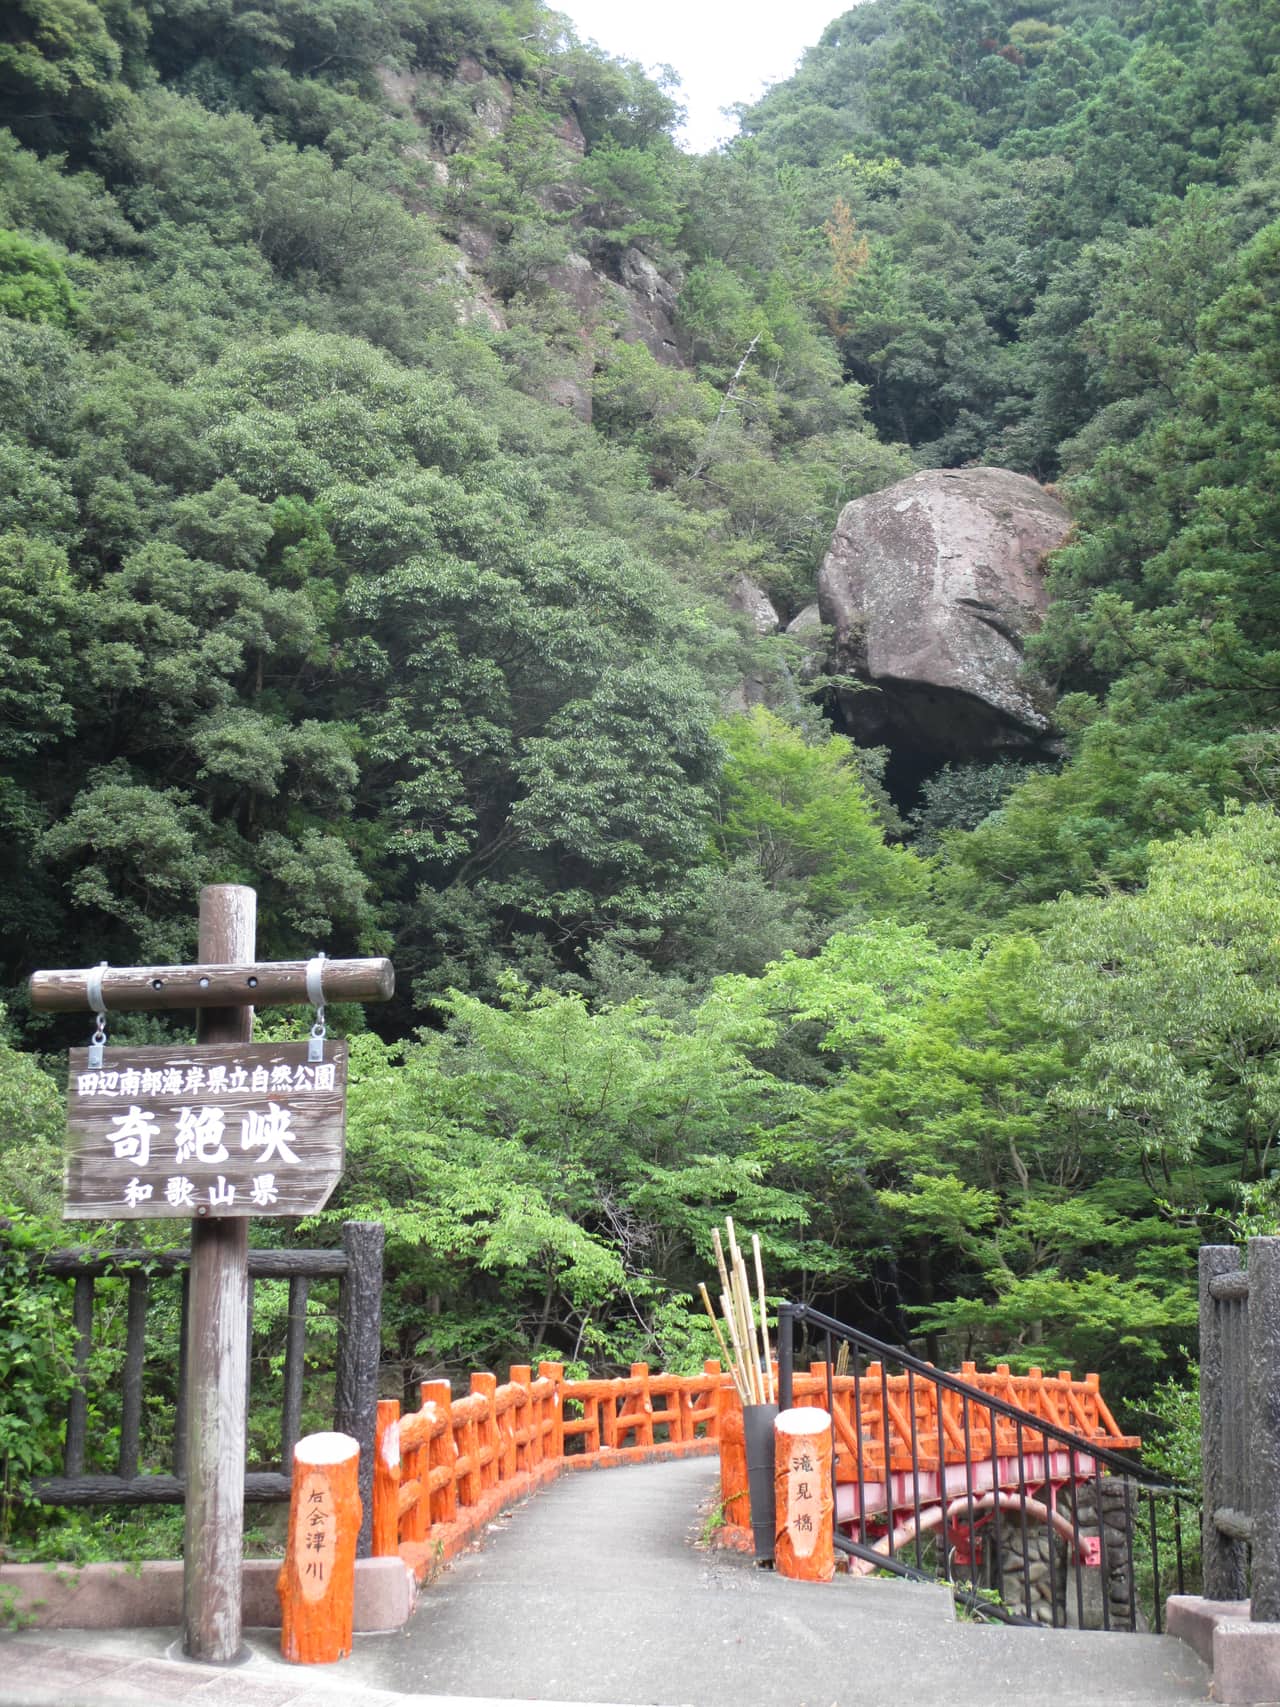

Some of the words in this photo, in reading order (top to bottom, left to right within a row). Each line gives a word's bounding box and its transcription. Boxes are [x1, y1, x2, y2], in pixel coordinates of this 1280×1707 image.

[77, 1064, 336, 1097] 田辺南部海岸県立自然公園
[106, 1102, 302, 1167] 奇絶峡
[124, 1173, 279, 1207] 和歌山県
[793, 1455, 813, 1533] 滝見橋
[306, 1489, 328, 1581] 右会津川
